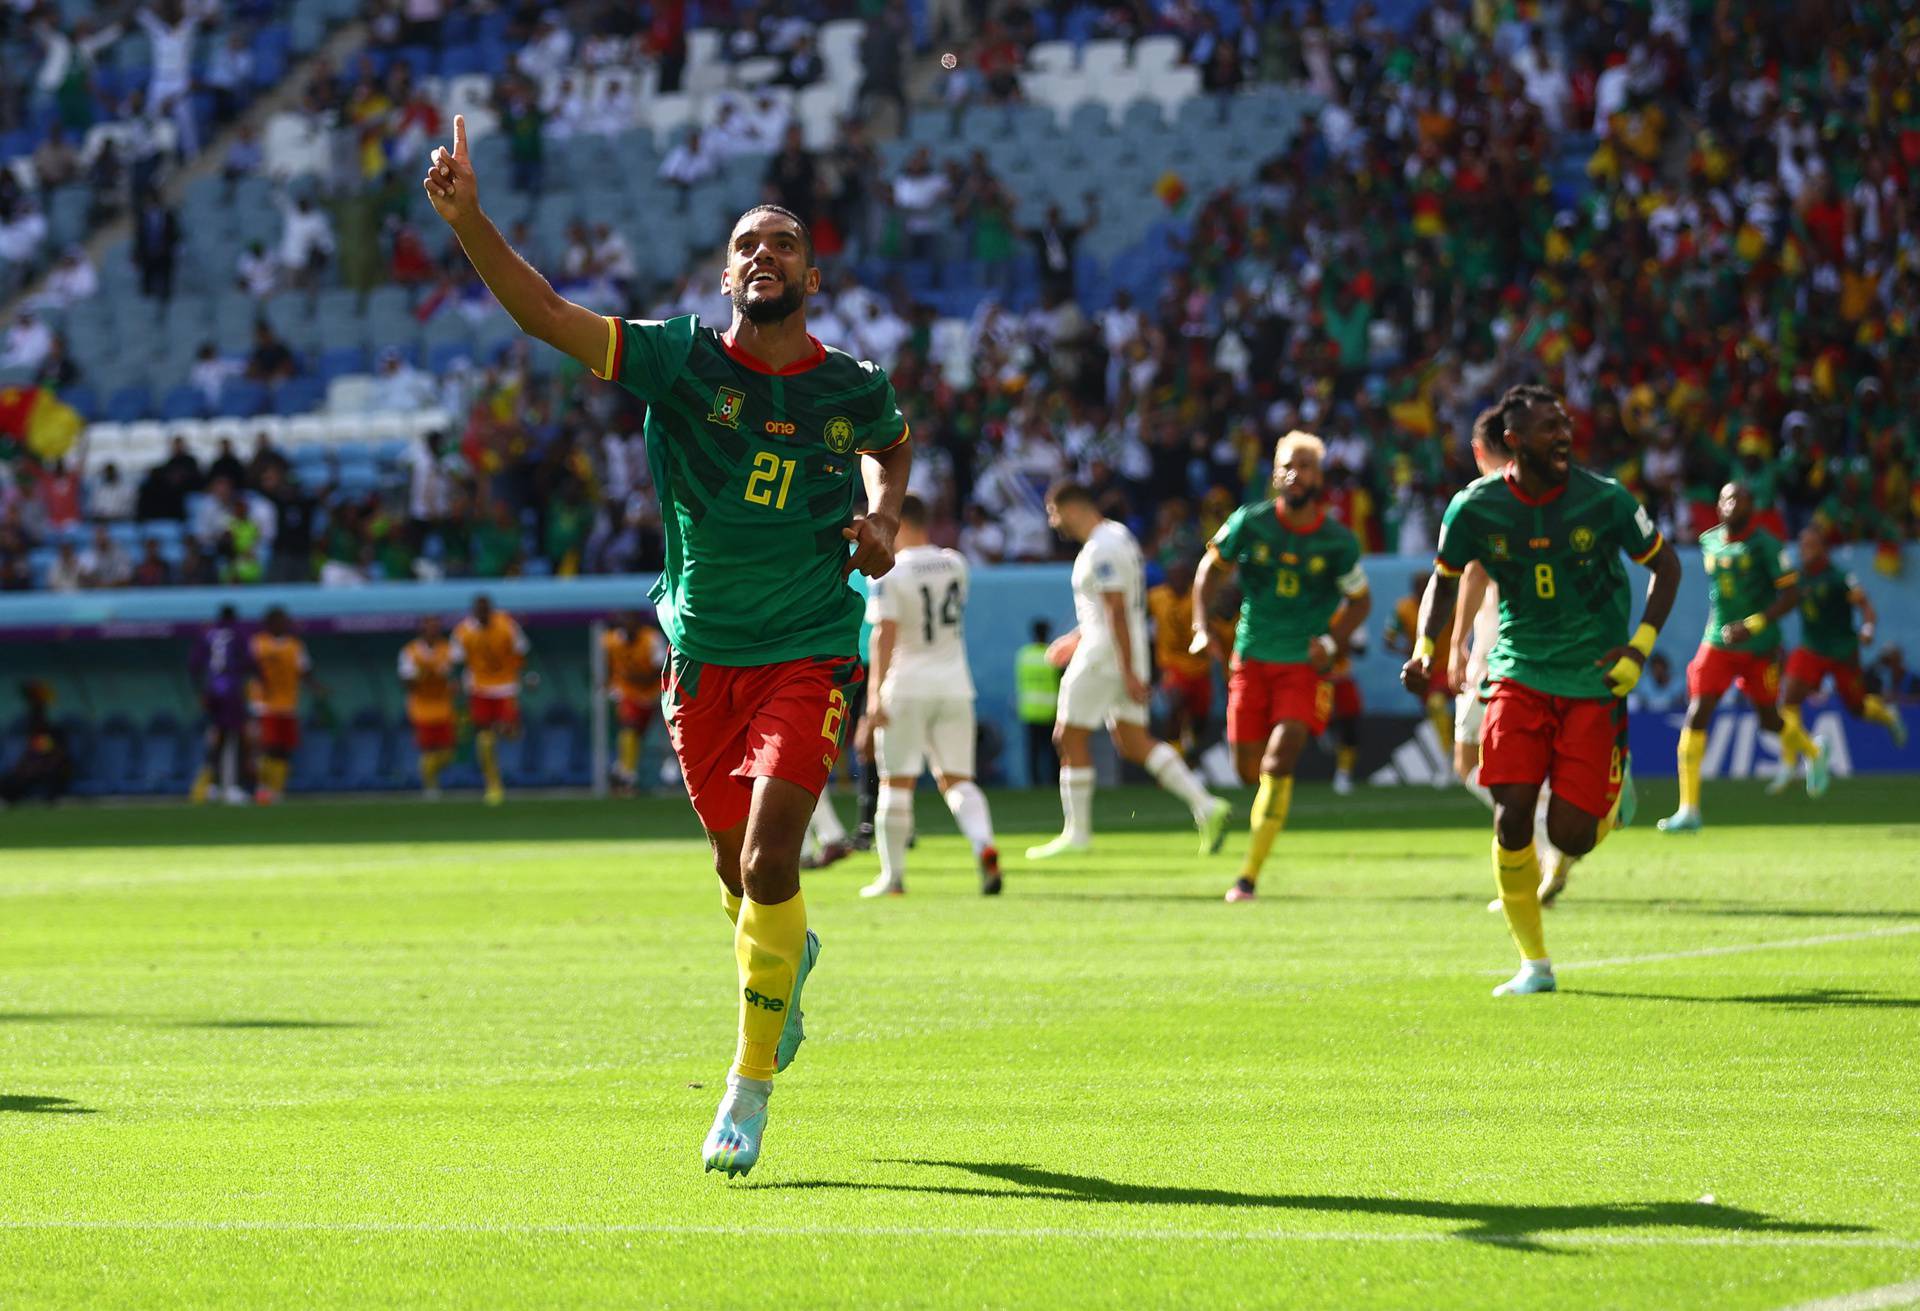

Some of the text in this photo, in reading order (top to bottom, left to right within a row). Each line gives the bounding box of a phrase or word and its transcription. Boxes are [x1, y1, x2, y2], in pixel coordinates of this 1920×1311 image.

[765, 420, 796, 435] one
[744, 451, 796, 510] 21
[1534, 563, 1556, 599] 8
[919, 578, 966, 646] 14
[744, 987, 785, 1012] one
